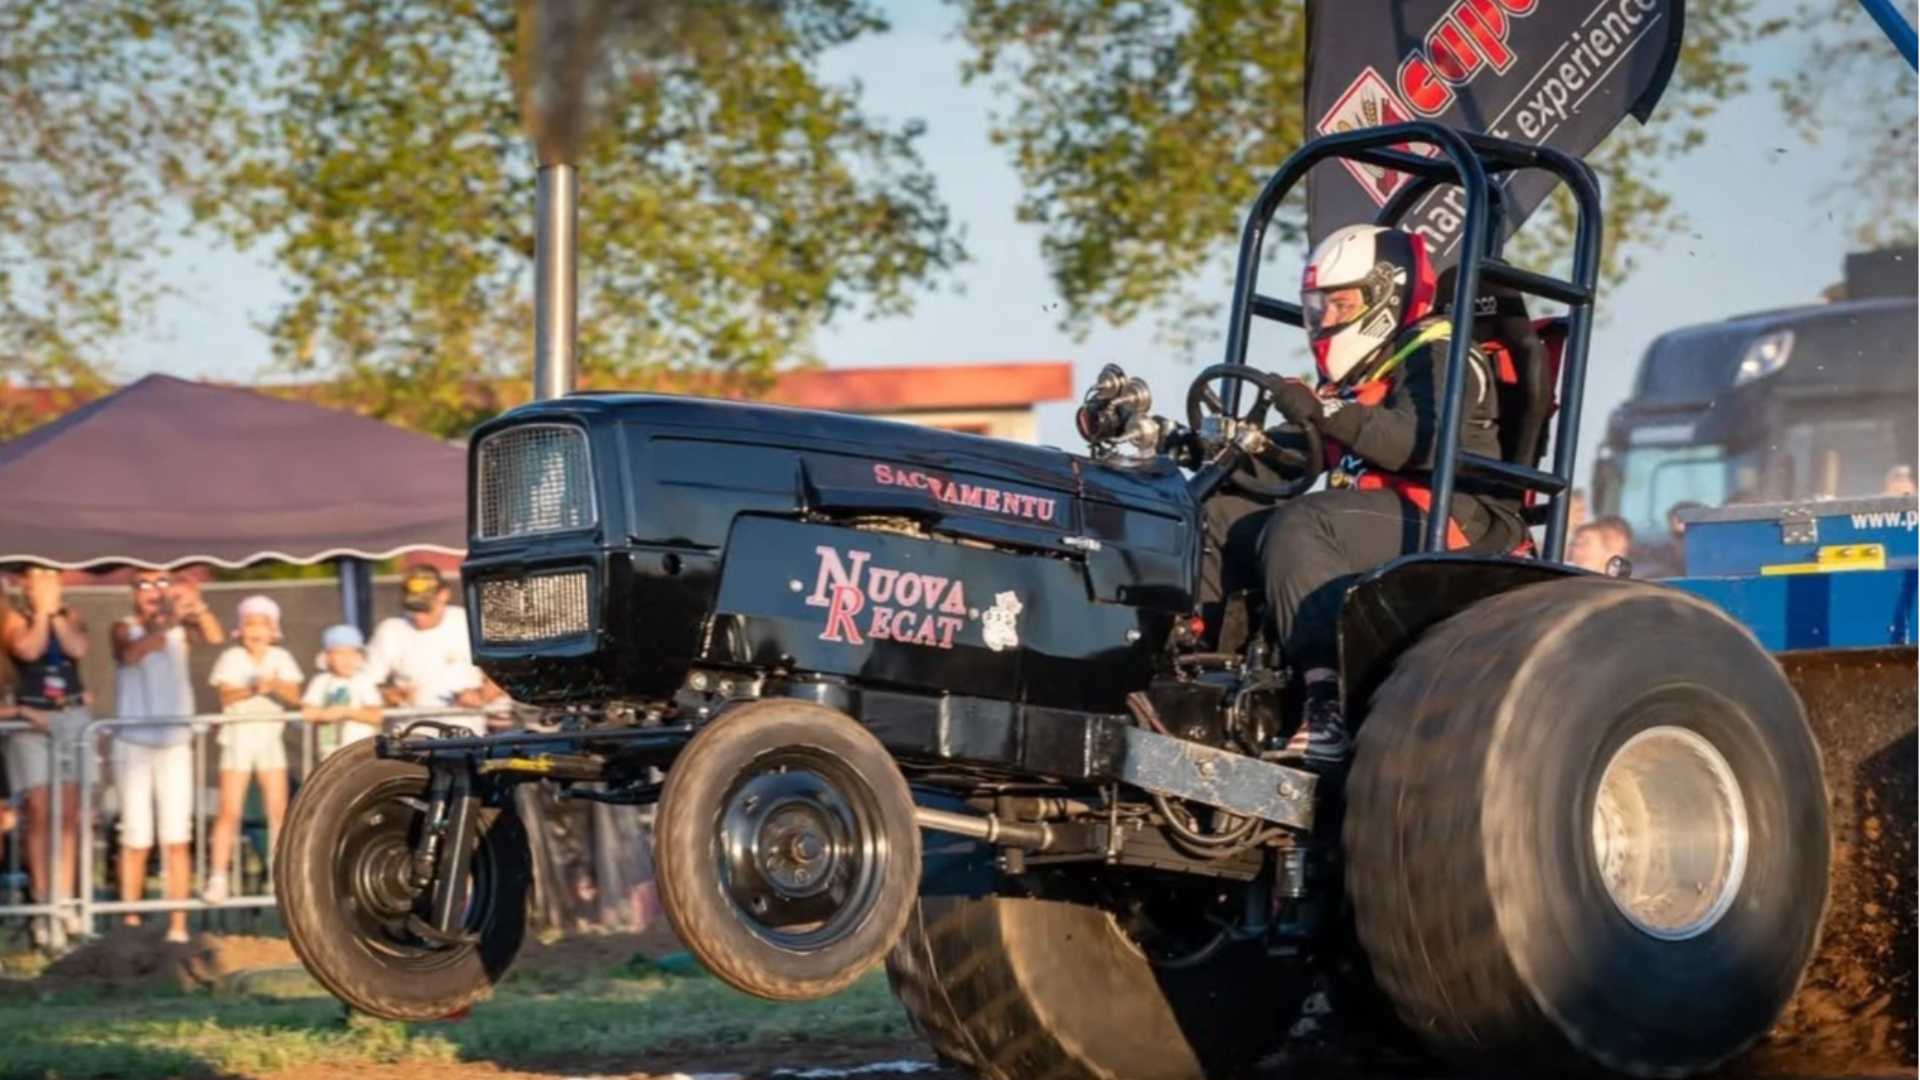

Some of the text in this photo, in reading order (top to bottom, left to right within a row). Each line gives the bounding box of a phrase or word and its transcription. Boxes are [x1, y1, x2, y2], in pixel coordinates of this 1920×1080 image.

[1397, 0, 1540, 118] cap
[872, 463, 1057, 521] SACRAMENTU
[805, 545, 967, 615] NUOVA
[818, 585, 963, 649] RECAT
